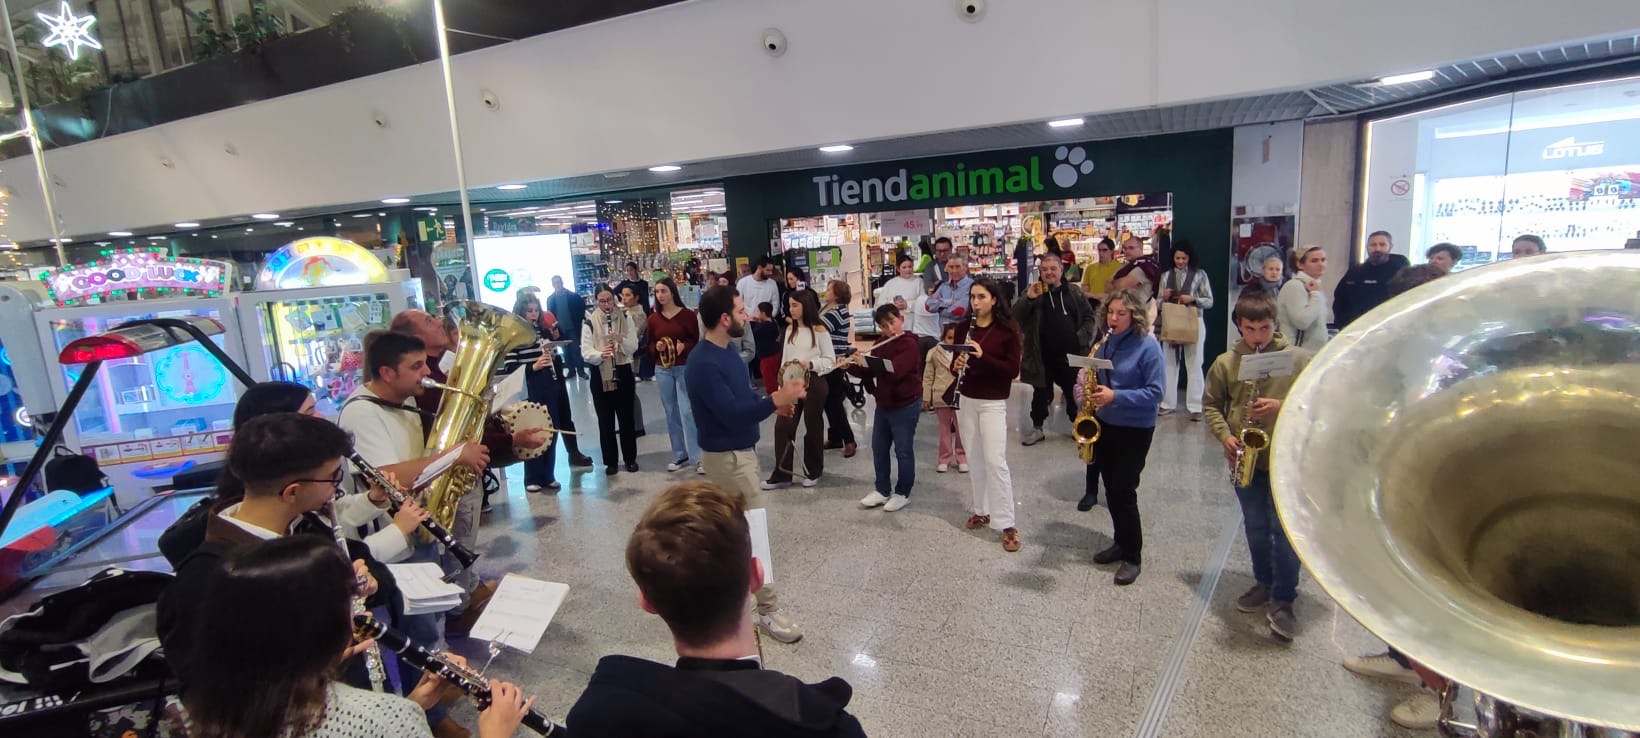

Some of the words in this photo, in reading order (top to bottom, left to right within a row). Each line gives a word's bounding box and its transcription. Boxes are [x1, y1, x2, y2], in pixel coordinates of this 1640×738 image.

[1542, 144, 1604, 160] LOTUS
[812, 156, 1044, 207] Tiendanimal
[72, 266, 142, 290] GOOD
[146, 264, 201, 284] LUCK
